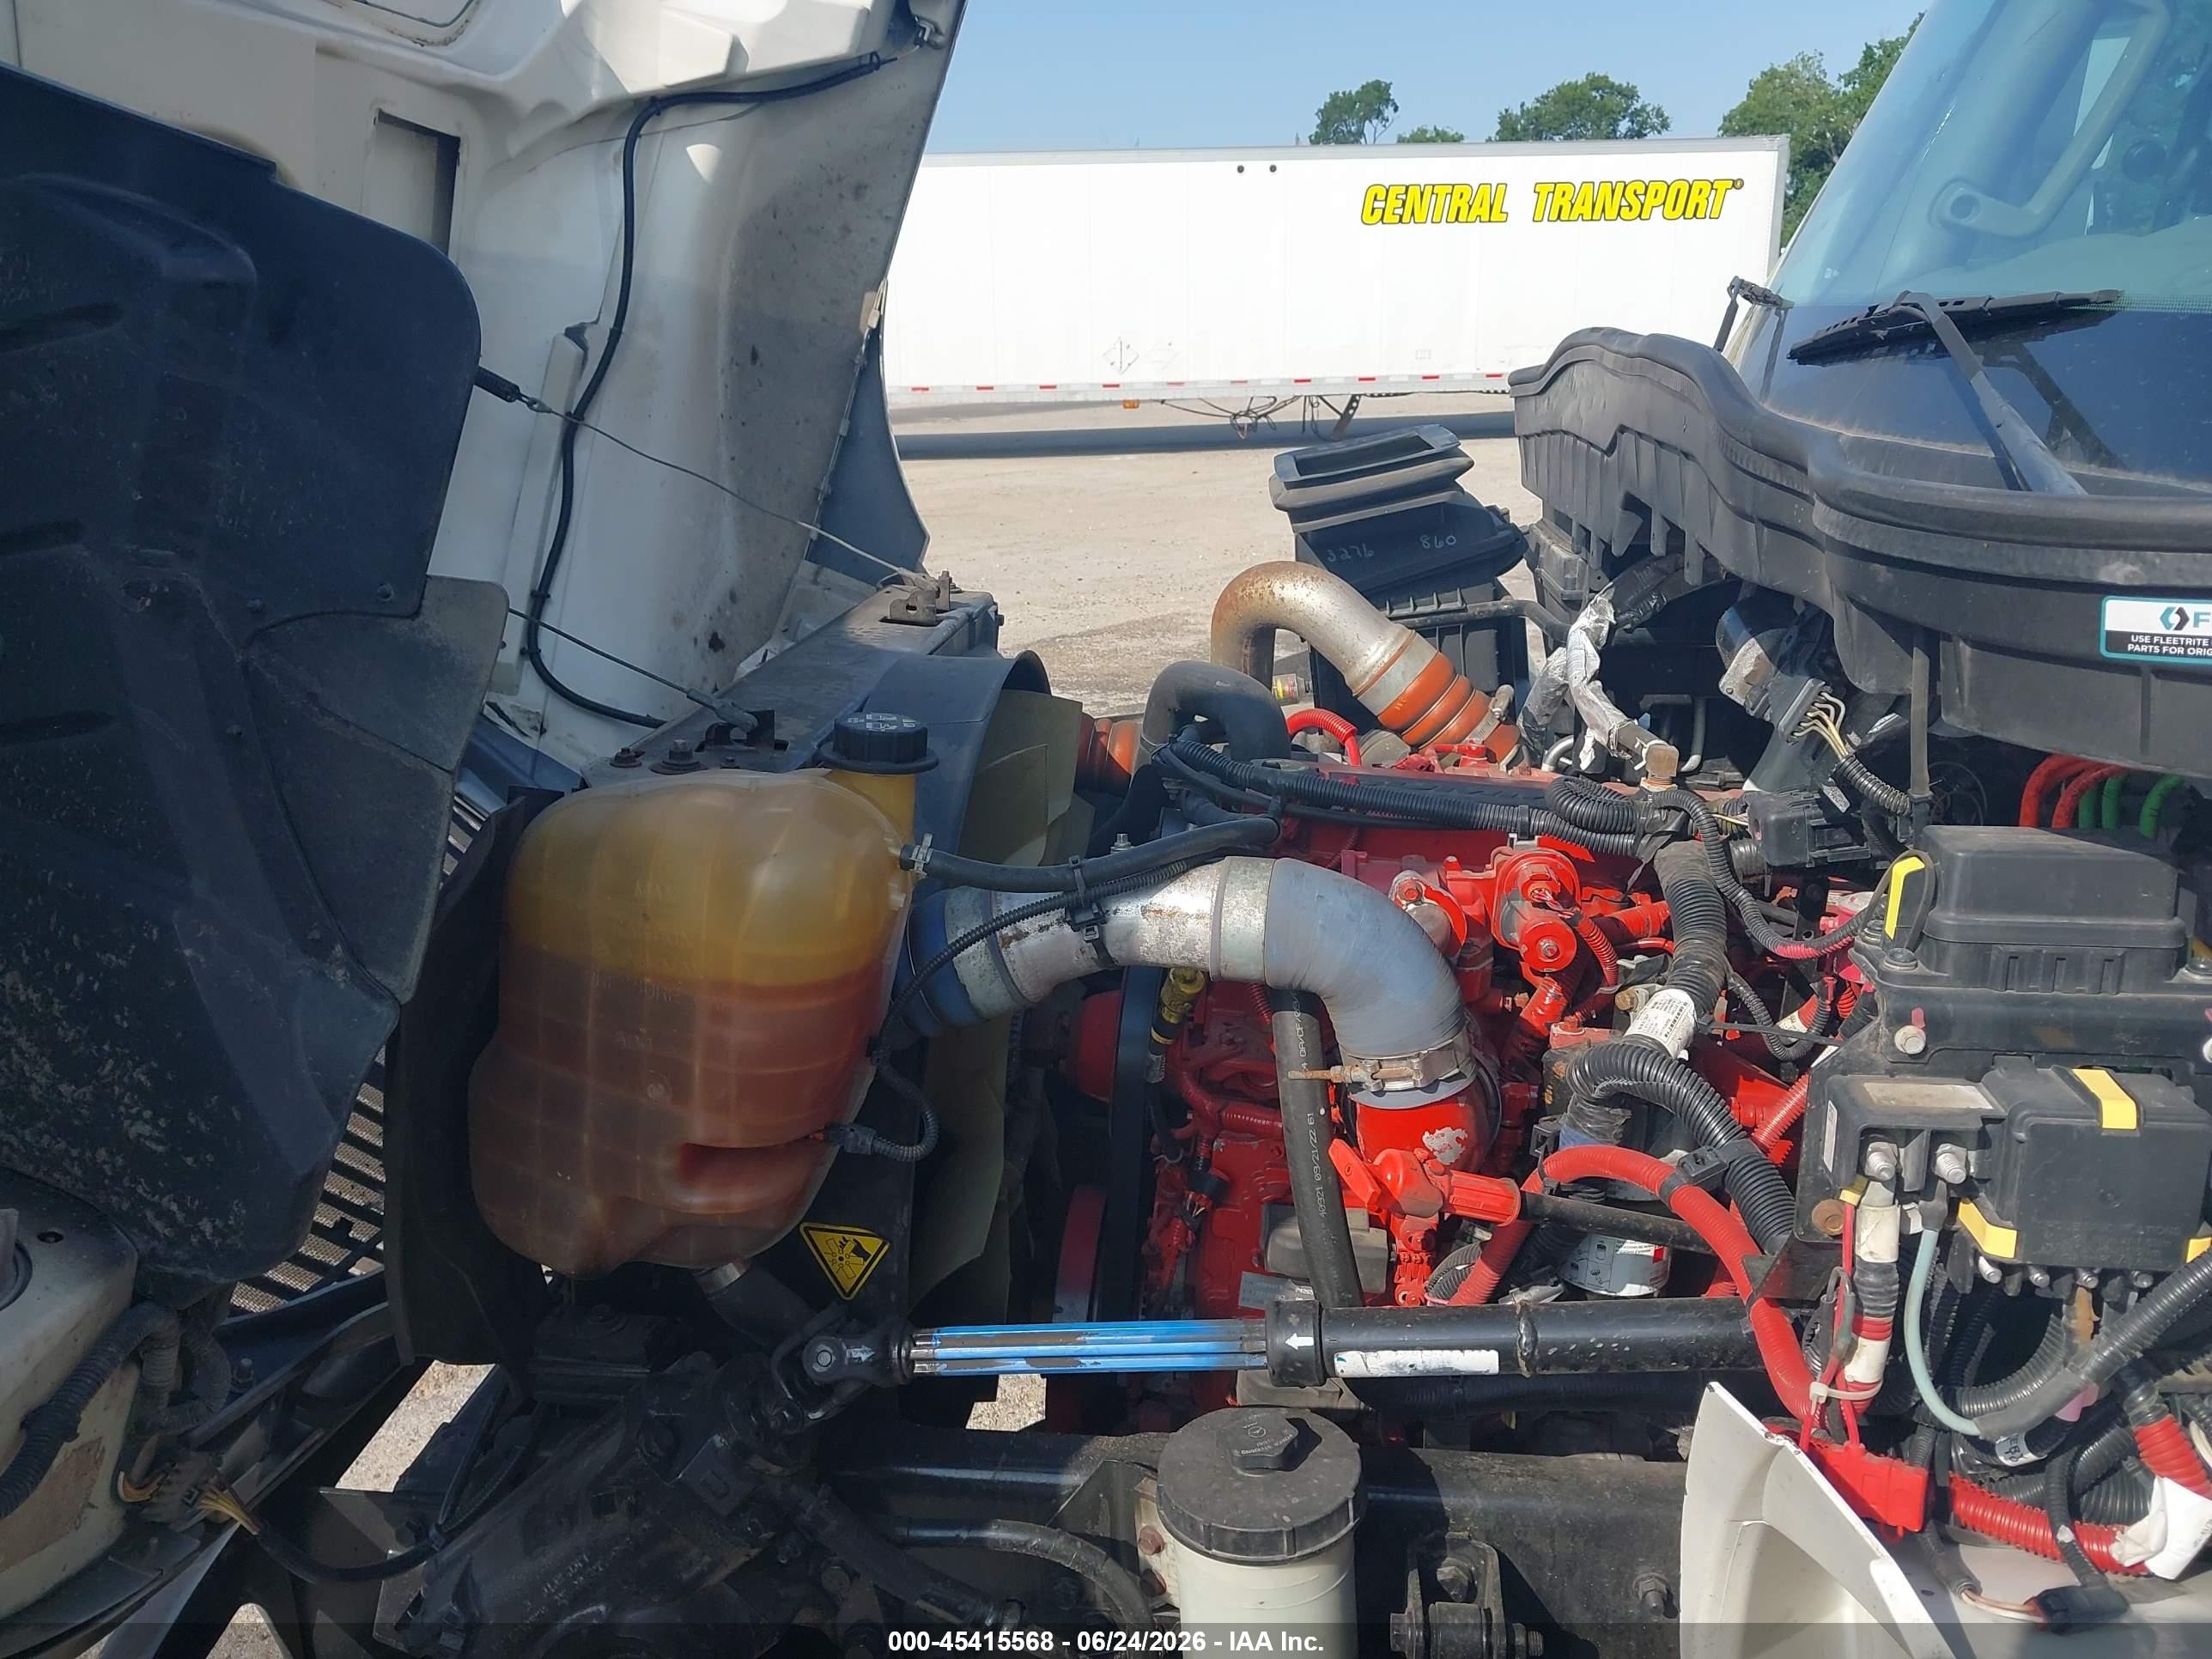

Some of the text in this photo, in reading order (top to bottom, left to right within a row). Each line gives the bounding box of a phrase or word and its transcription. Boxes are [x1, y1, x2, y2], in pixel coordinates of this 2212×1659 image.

[1361, 183, 1509, 225] CENTRAL
[2131, 635, 2209, 647] USE FLEETRITE
[2128, 643, 2160, 653] PARTS
[2162, 646, 2185, 655] FOR
